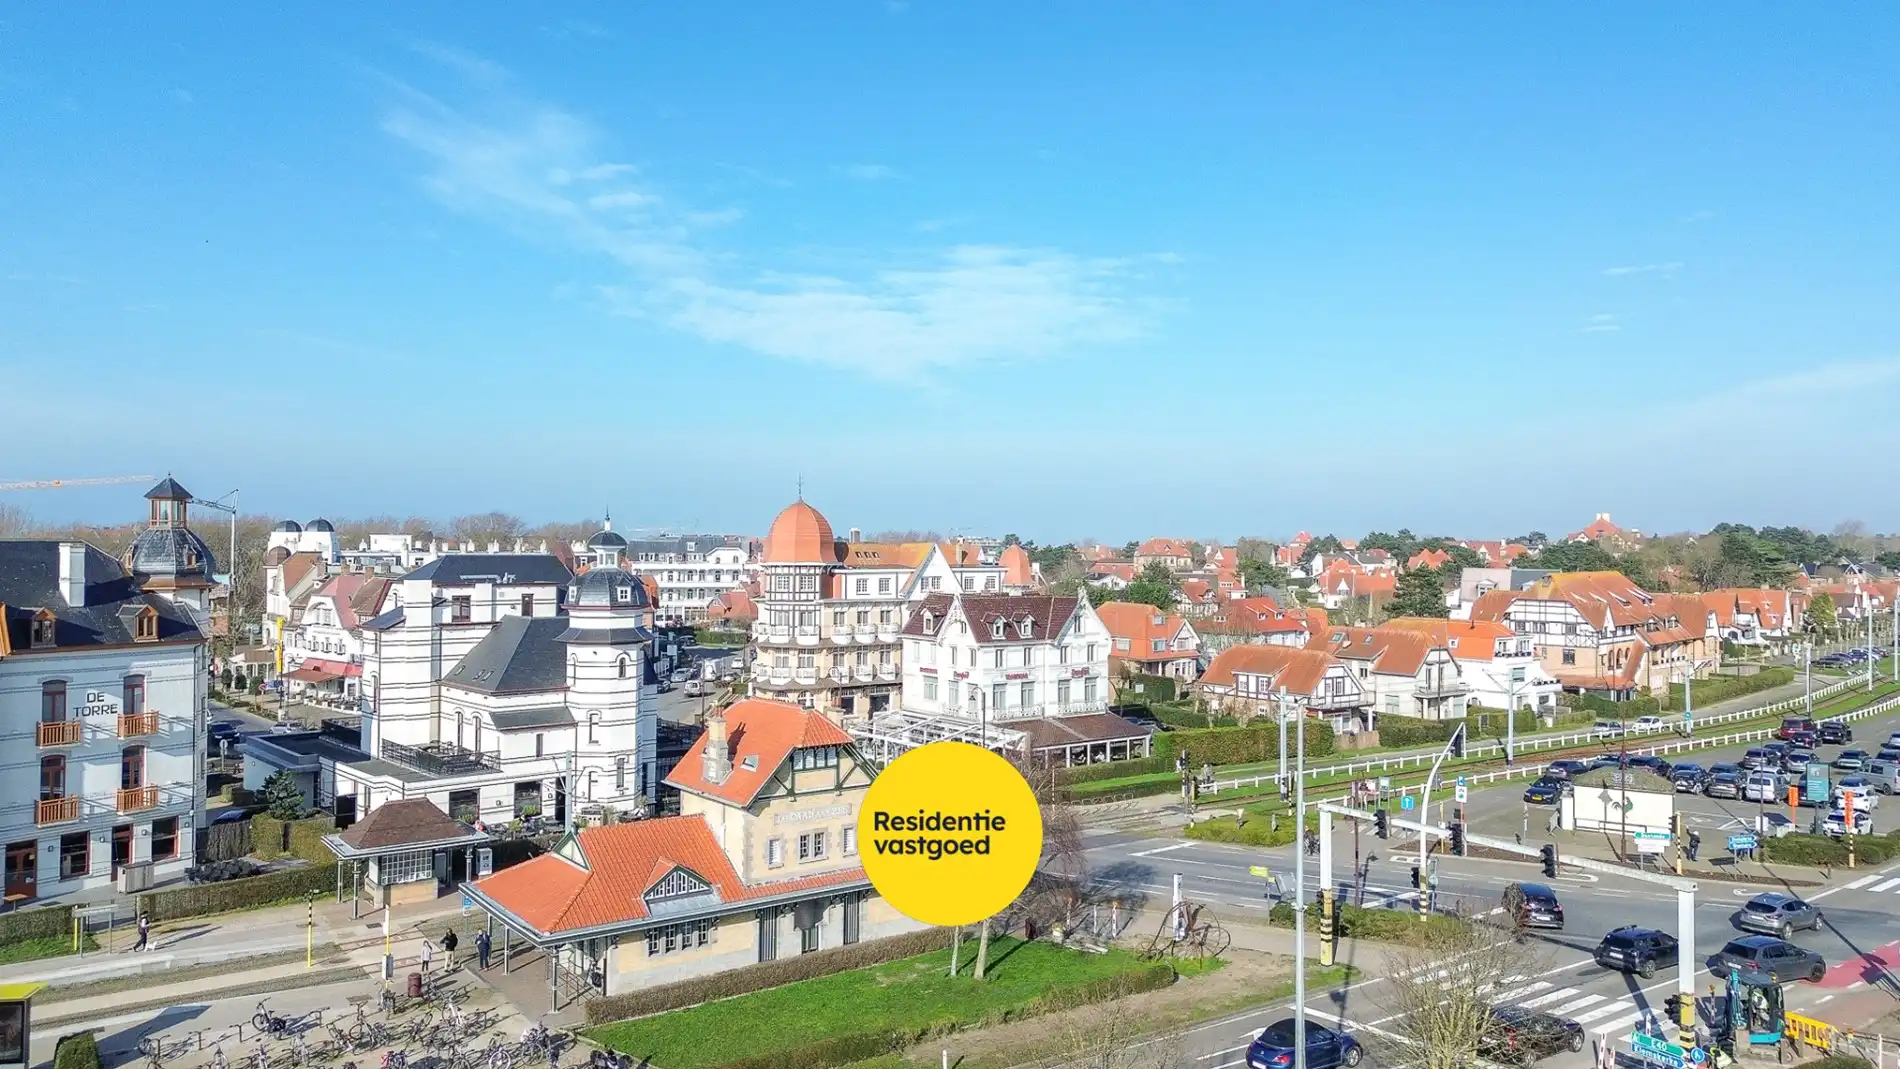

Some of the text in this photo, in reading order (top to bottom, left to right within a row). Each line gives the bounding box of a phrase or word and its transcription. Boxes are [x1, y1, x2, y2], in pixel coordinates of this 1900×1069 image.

[86, 691, 105, 703] DE
[73, 703, 118, 717] TORRE
[1652, 1038, 1667, 1051] E40
